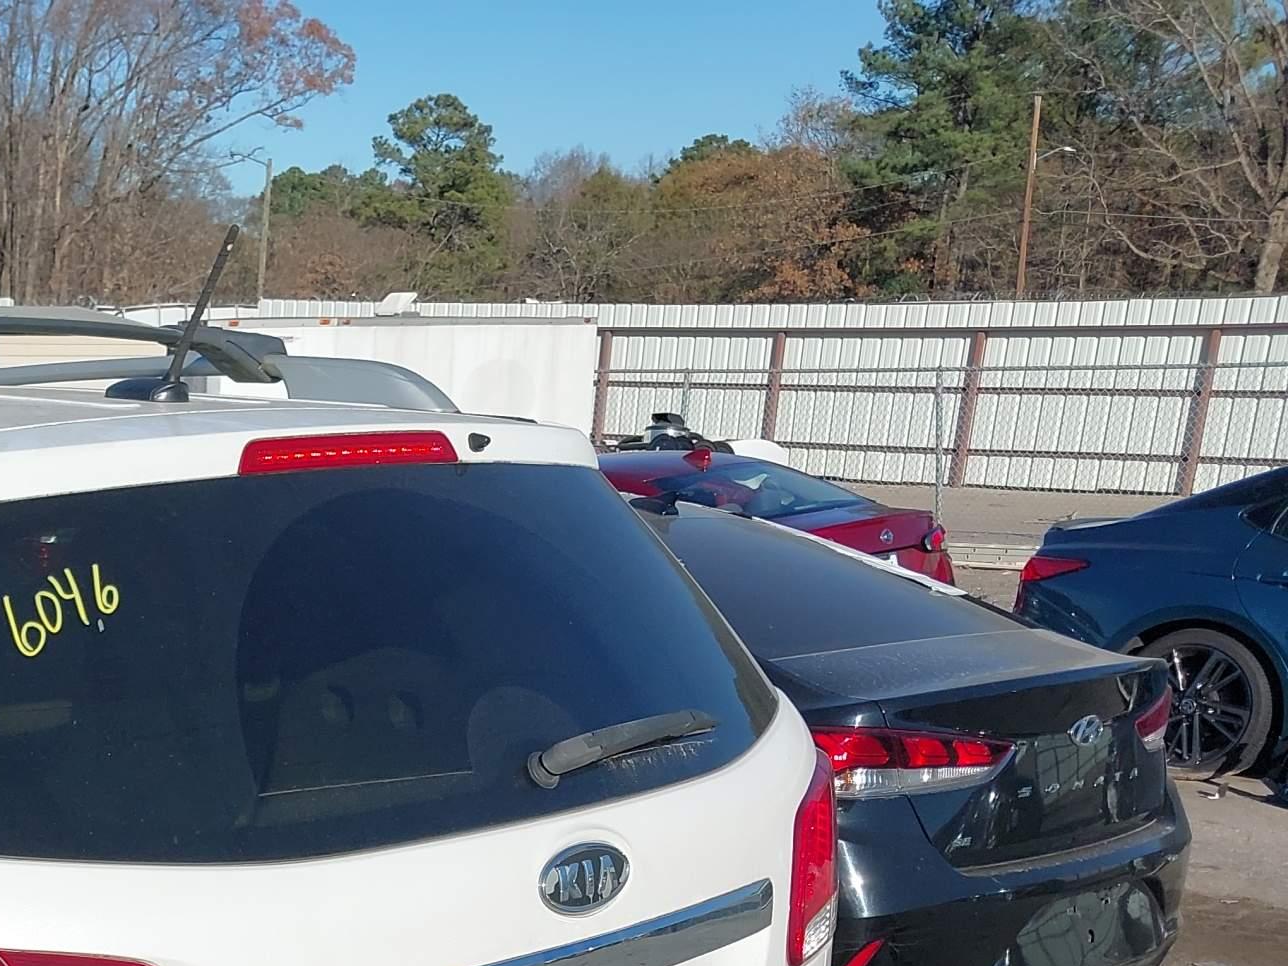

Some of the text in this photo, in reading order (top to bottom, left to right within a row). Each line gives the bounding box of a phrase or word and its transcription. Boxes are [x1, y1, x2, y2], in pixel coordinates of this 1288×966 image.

[2, 563, 119, 657] 6046
[1017, 767, 1138, 798] SONATA
[558, 854, 617, 902] KIA
